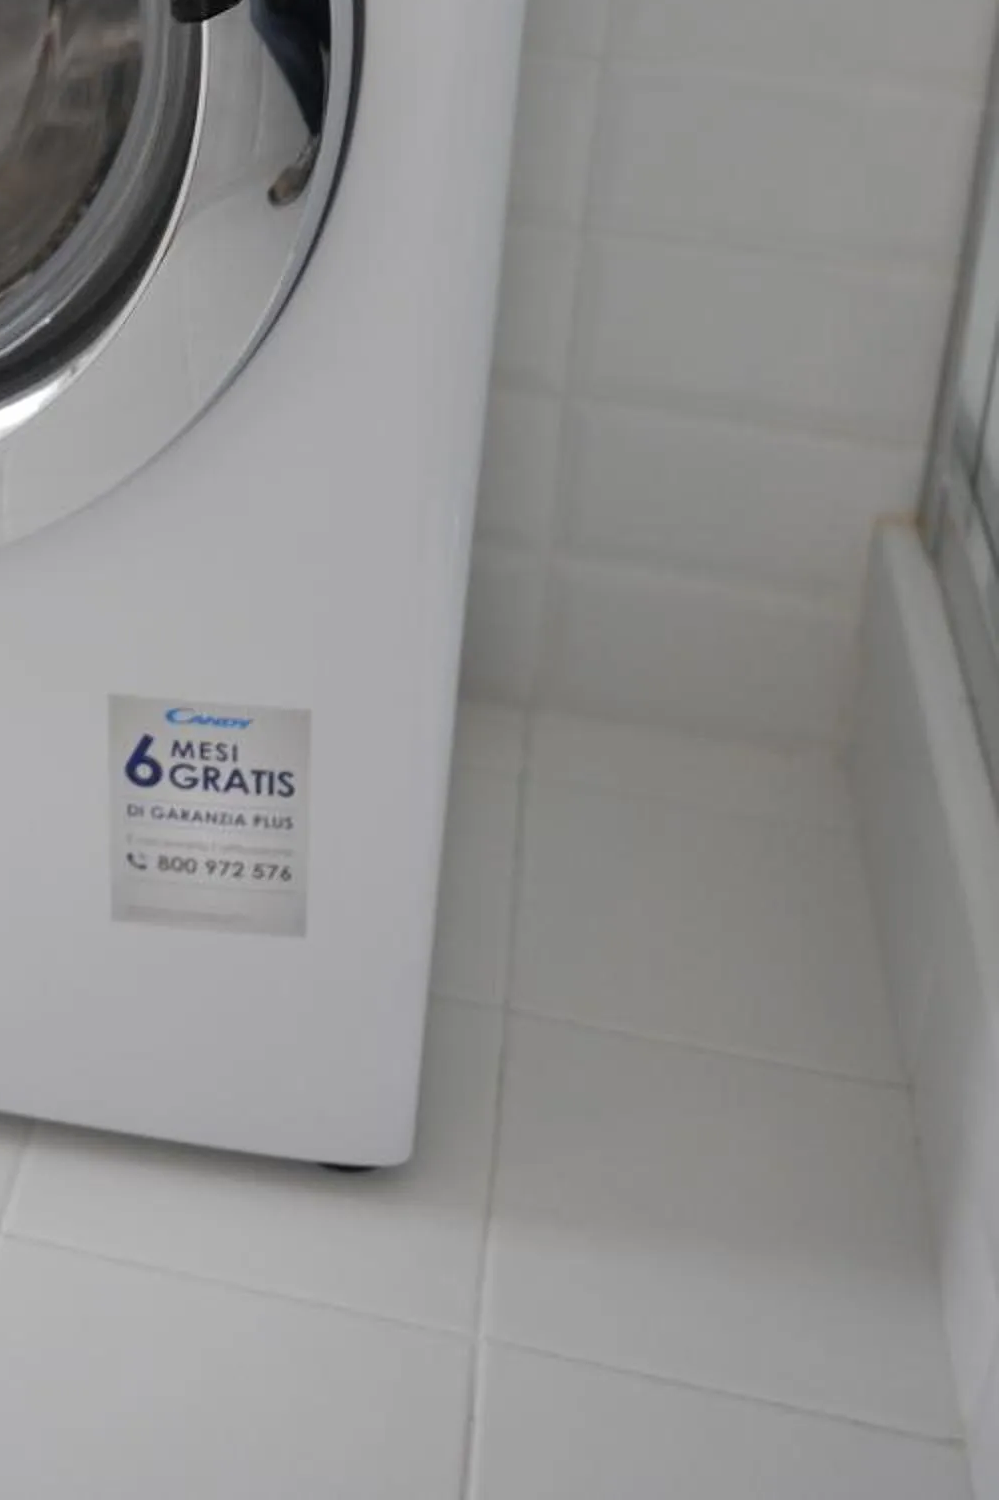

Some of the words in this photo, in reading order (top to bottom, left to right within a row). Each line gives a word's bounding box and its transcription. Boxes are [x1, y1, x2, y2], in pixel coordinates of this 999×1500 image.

[124, 733, 164, 788] 6
[170, 739, 239, 763] MESI
[168, 763, 296, 799] GRATIS
[126, 803, 145, 818] DI
[149, 805, 248, 828] GARANZIA
[252, 815, 295, 831] PLUS
[157, 854, 199, 875] 800
[204, 859, 246, 879] 972
[251, 862, 293, 883] 576
